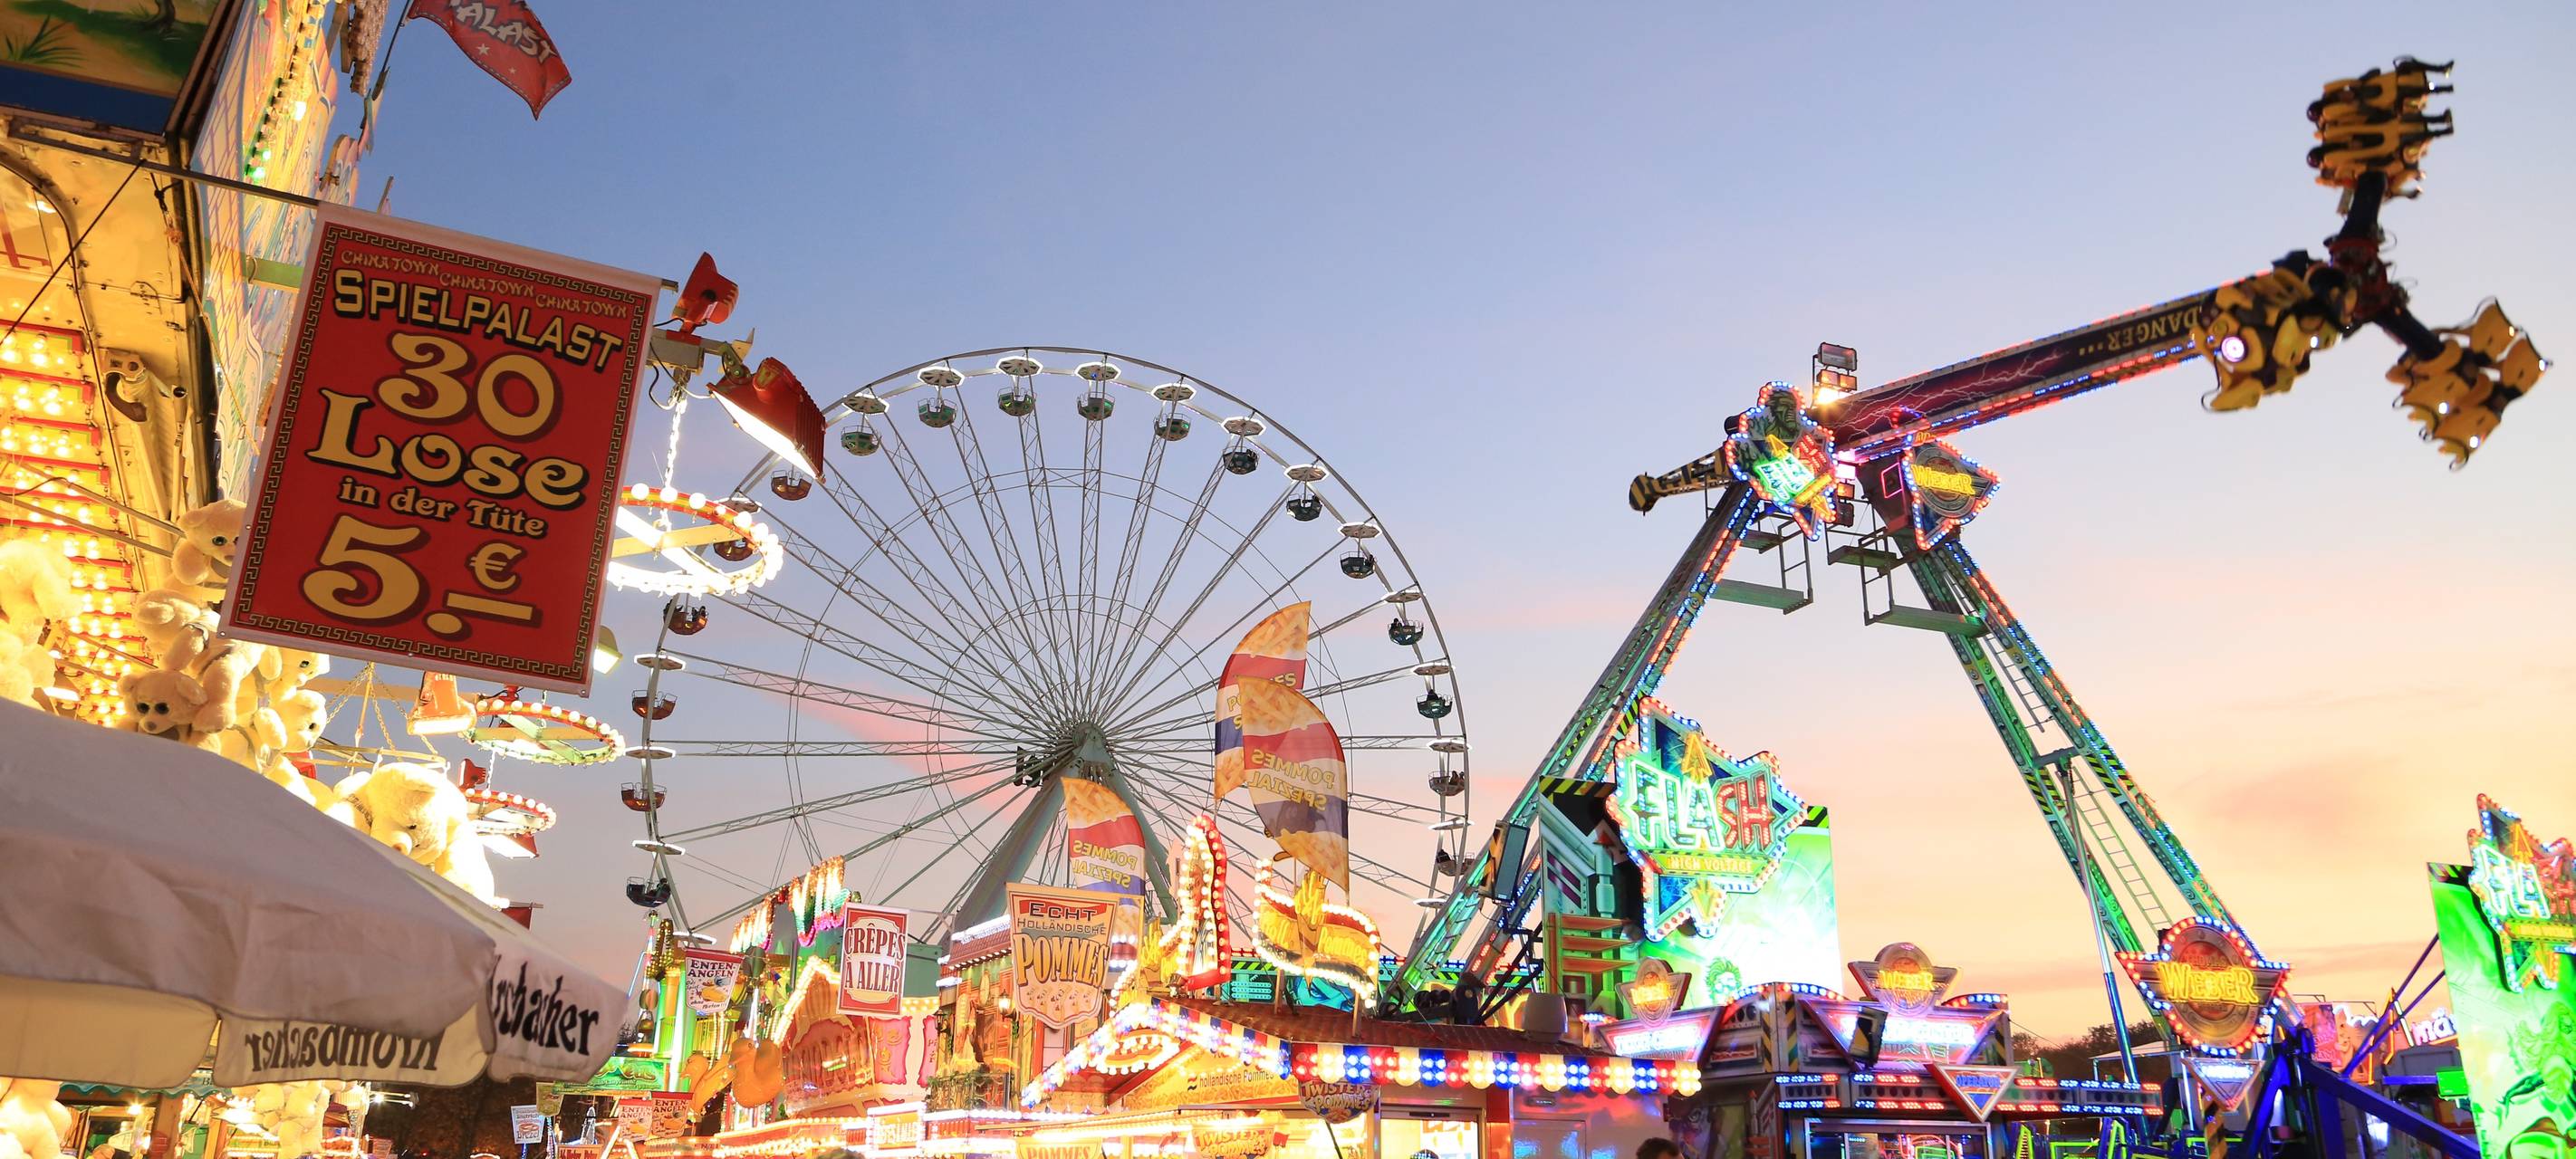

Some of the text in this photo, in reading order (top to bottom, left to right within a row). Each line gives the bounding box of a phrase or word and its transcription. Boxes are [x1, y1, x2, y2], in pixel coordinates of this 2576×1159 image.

[333, 269, 623, 372] SPIELPALAST
[378, 332, 558, 437] 30
[338, 476, 548, 539] in der Tüte
[1627, 759, 1777, 856] FLASH
[1017, 917, 1107, 936] HOLLÄNDISCHE
[1029, 902, 1097, 922] ECHT
[843, 922, 906, 961] CRÊPES
[1013, 933, 1110, 989] POMMES
[857, 961, 900, 993] ALLER
[2157, 961, 2258, 1004] WEBER
